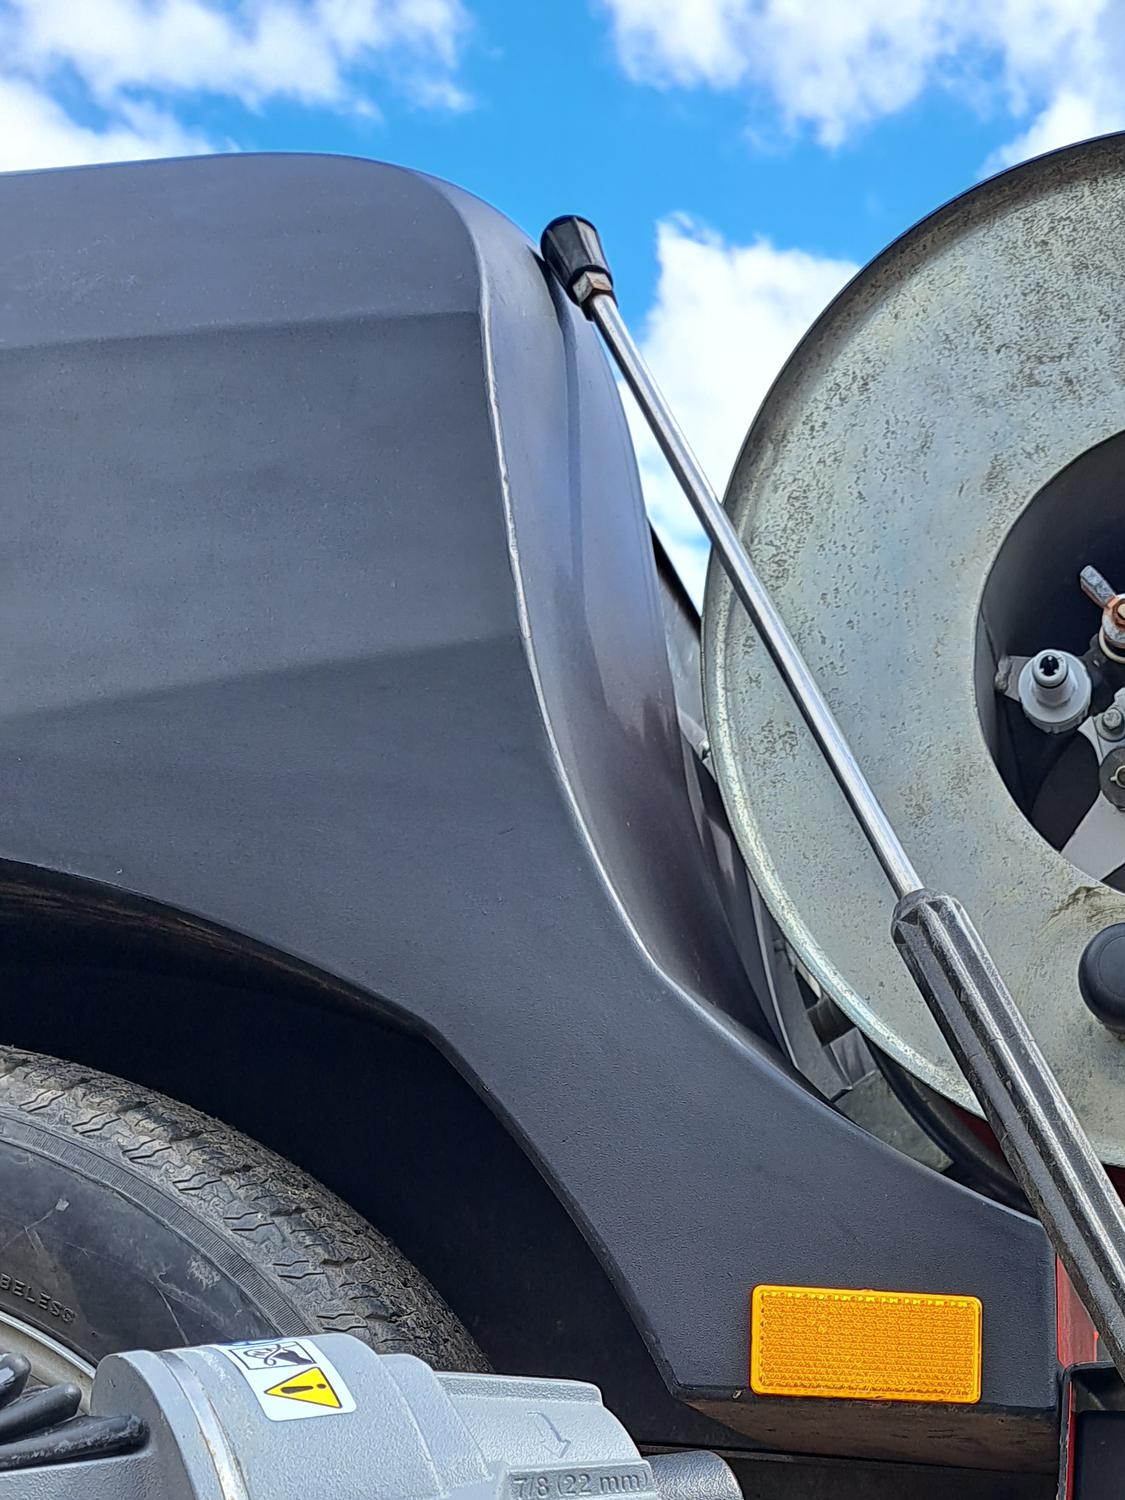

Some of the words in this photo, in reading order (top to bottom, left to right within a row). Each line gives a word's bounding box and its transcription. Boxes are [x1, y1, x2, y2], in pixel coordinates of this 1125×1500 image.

[513, 1475, 549, 1500] 7/8
[556, 1472, 592, 1496] (22
[600, 1470, 649, 1493] mm)
